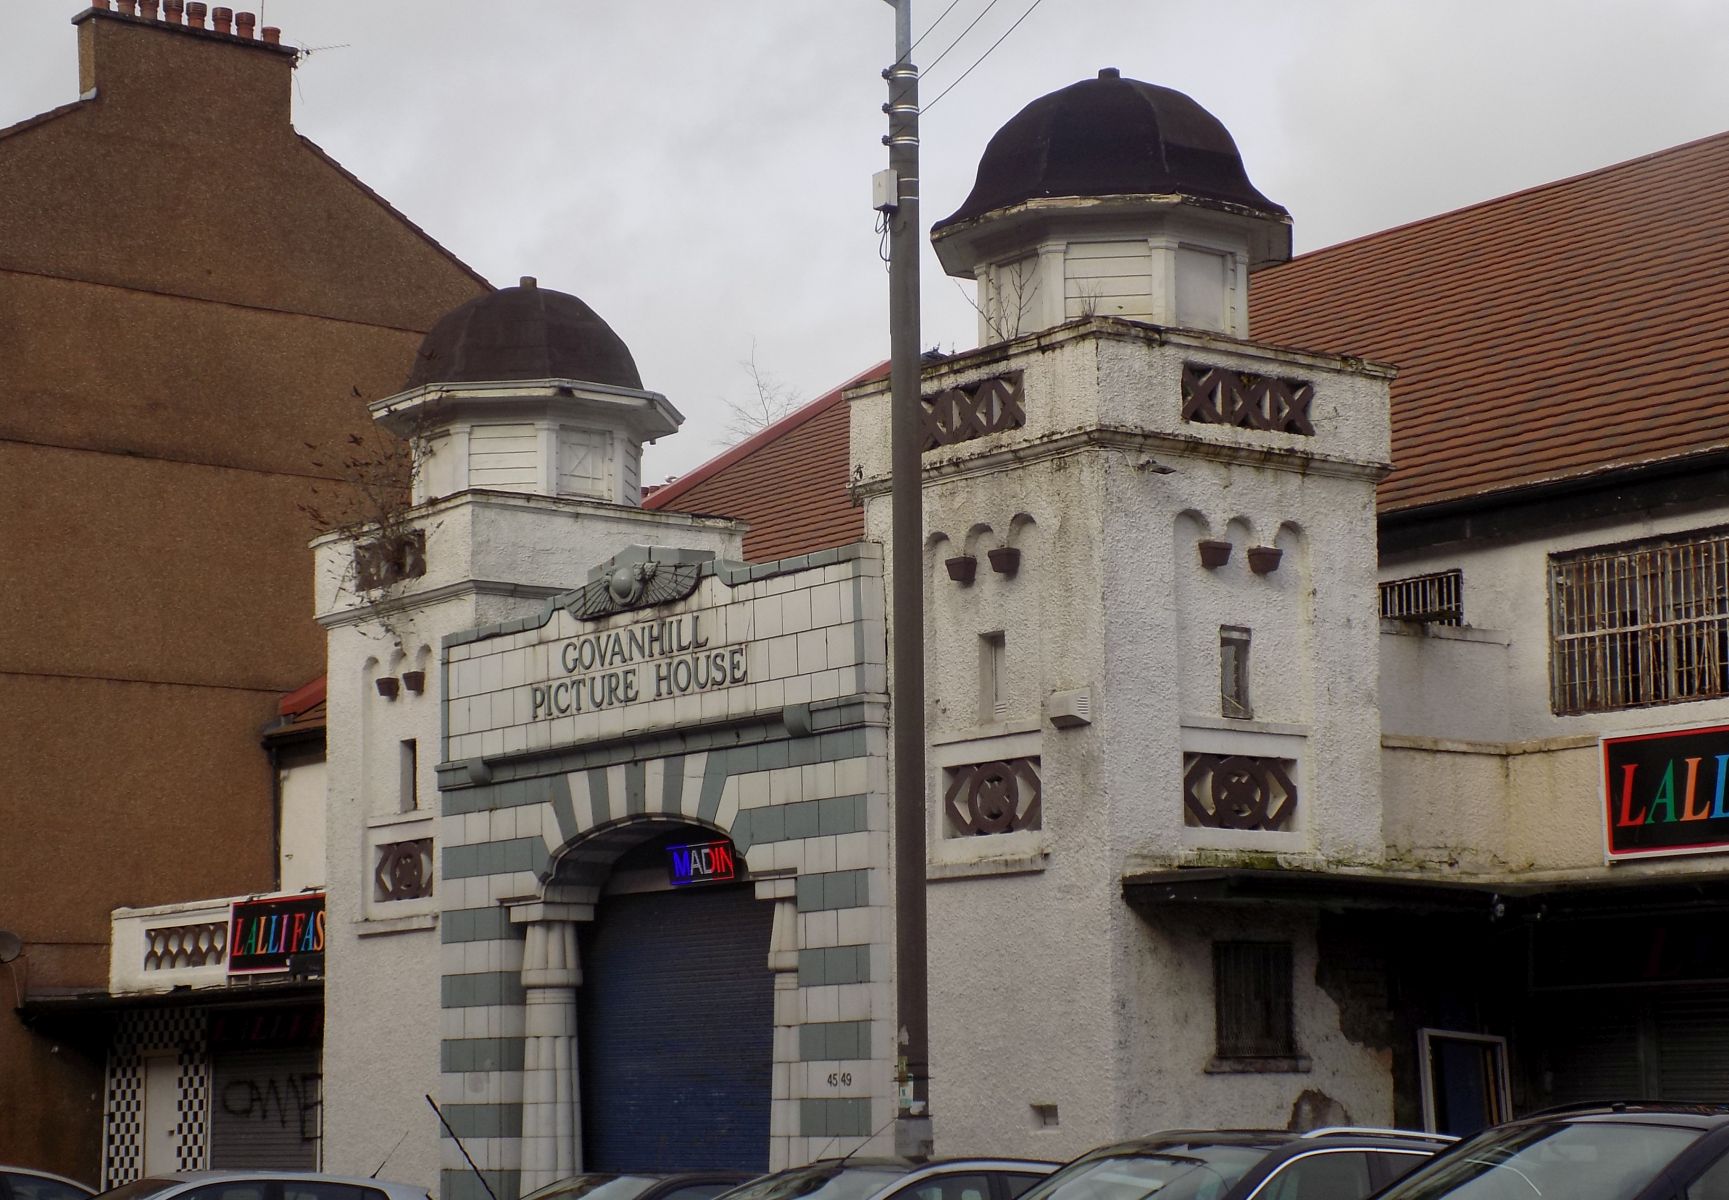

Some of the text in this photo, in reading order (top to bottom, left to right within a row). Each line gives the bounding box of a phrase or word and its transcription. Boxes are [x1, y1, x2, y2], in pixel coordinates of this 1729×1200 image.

[562, 615, 709, 673] GOVANHILL
[531, 648, 747, 720] PICTURE HOUSE
[232, 914, 289, 955] LALLI
[827, 1072, 852, 1087] 45 49
